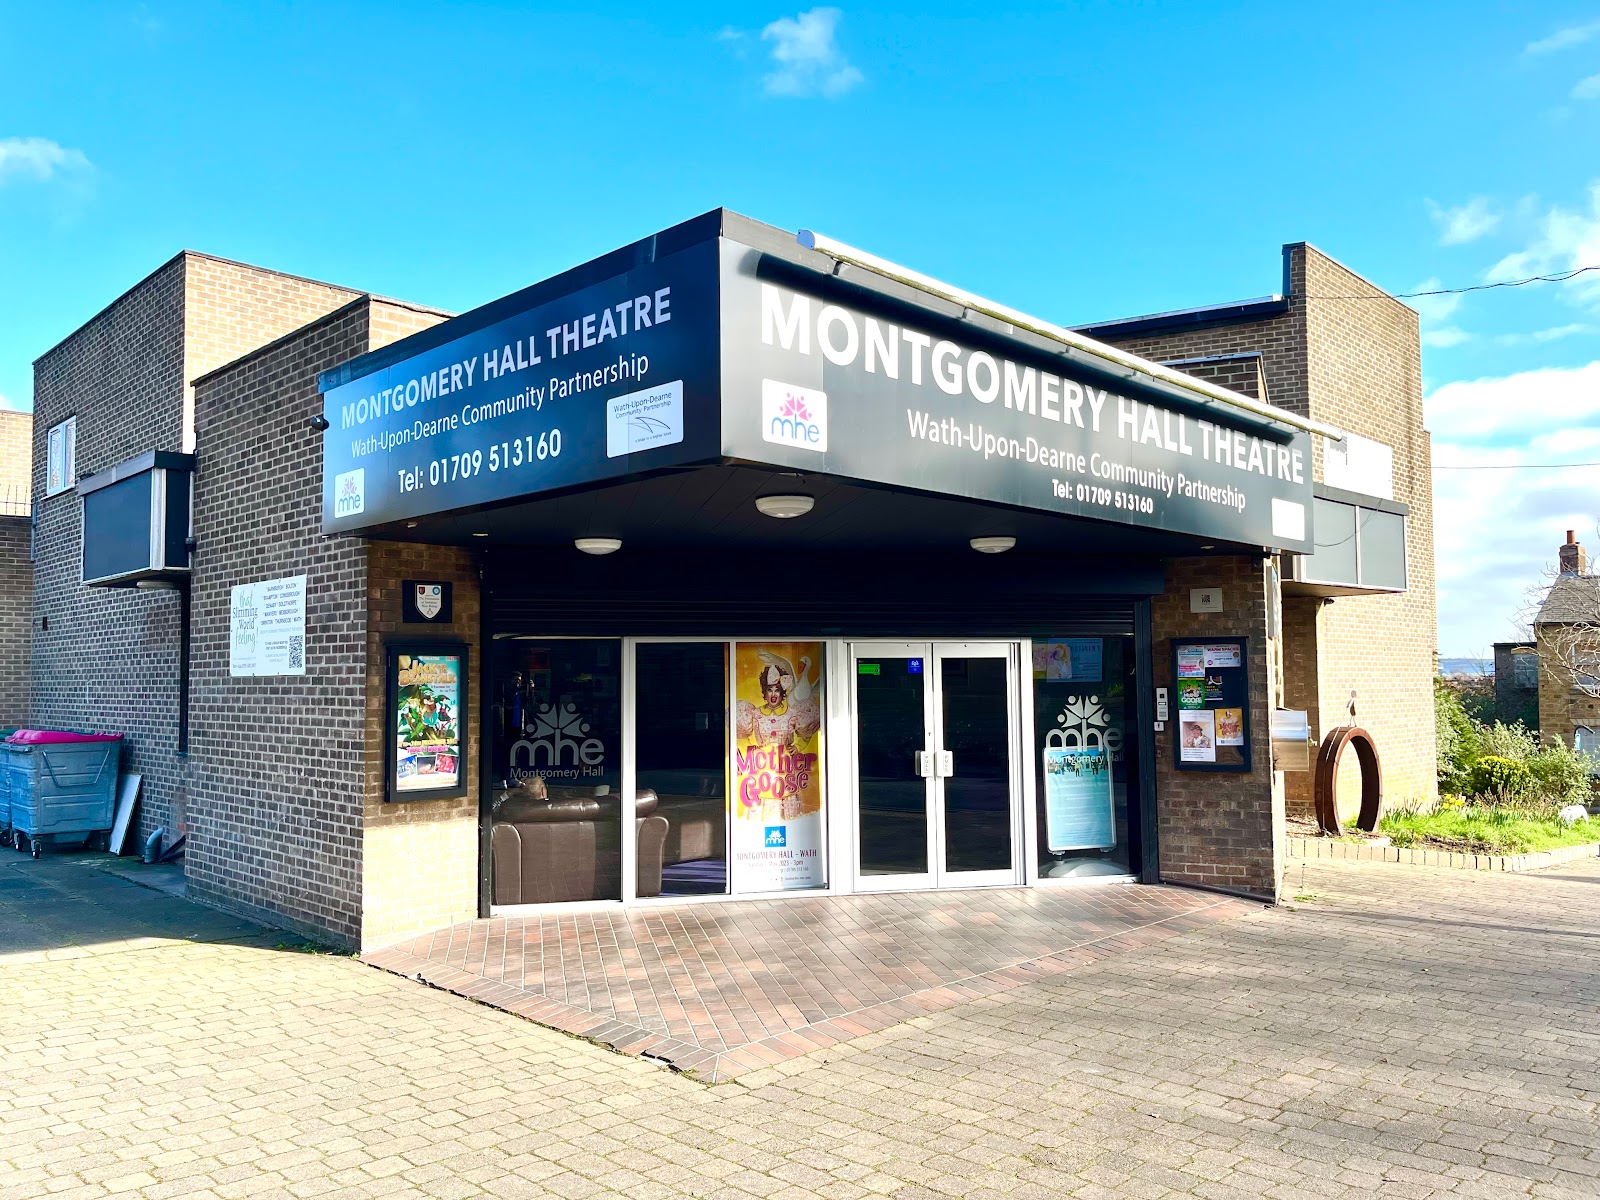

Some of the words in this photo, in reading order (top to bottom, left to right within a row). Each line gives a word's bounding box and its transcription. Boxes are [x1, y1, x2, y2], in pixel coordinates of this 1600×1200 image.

[342, 356, 477, 430] MONTGOMERY
[483, 335, 541, 381] HALL
[546, 286, 671, 359] THEATRE
[761, 282, 1108, 432] MONTGOMERY
[1118, 395, 1192, 456] HALL
[1198, 419, 1304, 485] THEATRE
[351, 413, 458, 458] Wath-Upon-Dearne
[461, 386, 545, 426] Community
[550, 353, 649, 401] Partnership
[614, 392, 672, 412] Wath-Upon-Dearne
[616, 407, 642, 419] Community
[643, 400, 672, 412] Partnership
[771, 413, 820, 443] mhe
[398, 466, 424, 493] Tel:
[429, 449, 483, 486] 01709
[488, 429, 562, 472] 513160
[907, 408, 1086, 474] Wath-Upon-Dearne
[1091, 453, 1174, 498] Community
[1177, 473, 1246, 513] Partnership
[337, 490, 361, 513] mhe
[1052, 479, 1073, 500] Tel:
[1076, 483, 1112, 506] 01709
[1115, 491, 1154, 514] 513160
[232, 606, 259, 620] Slimming
[238, 618, 255, 630] World
[399, 670, 457, 686] BEANSTALK
[409, 660, 436, 675] JACK
[510, 728, 605, 767] mhe
[1045, 719, 1125, 752] mhe
[510, 767, 580, 780] Montgomery
[583, 766, 604, 777] Hall
[736, 744, 817, 776] Mother
[1048, 754, 1105, 766] Montgomery
[1107, 752, 1124, 762] Hall
[740, 771, 809, 808] Goose
[778, 850, 794, 859] HALL
[799, 849, 817, 858] WATH
